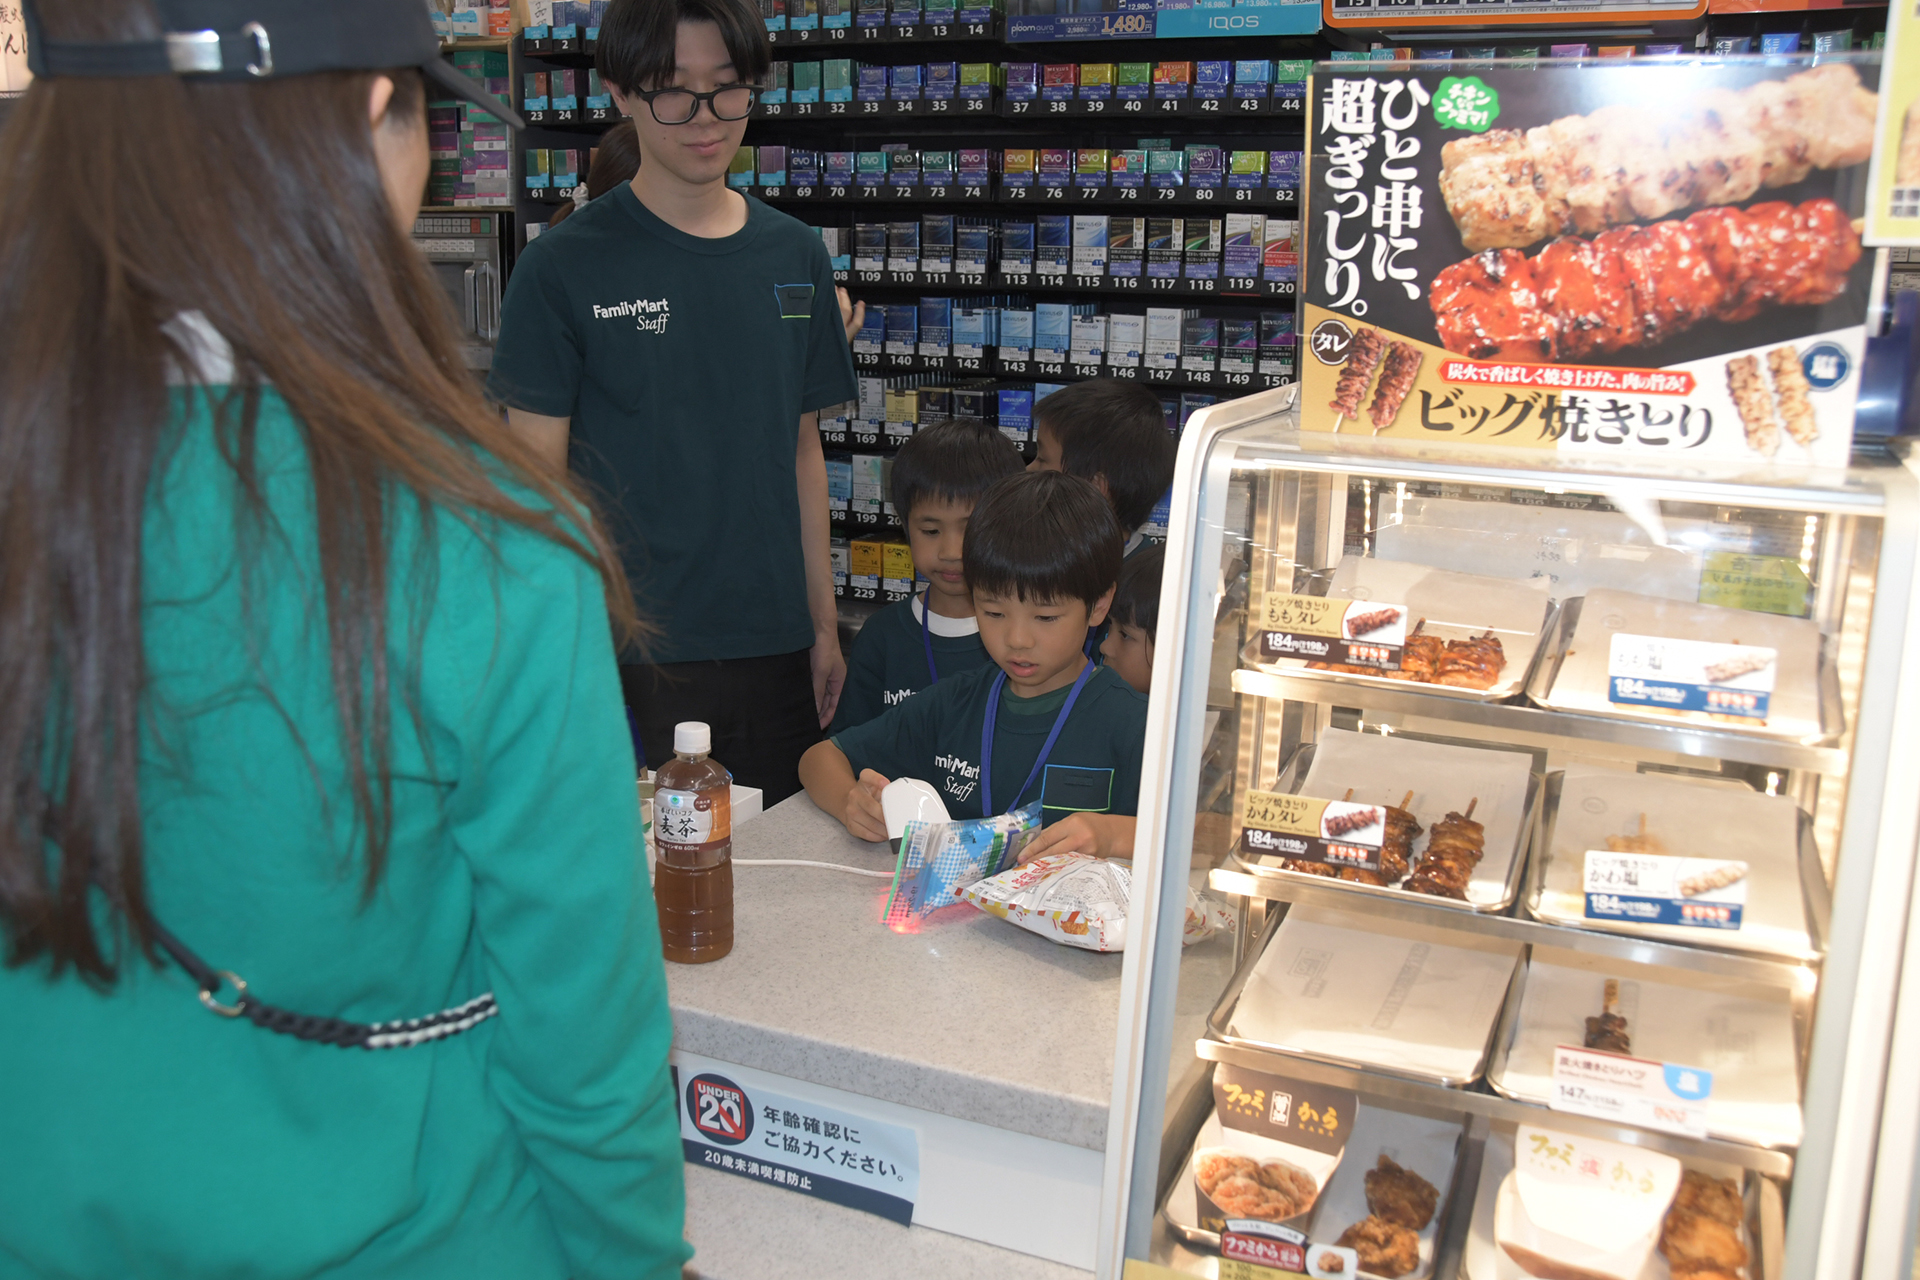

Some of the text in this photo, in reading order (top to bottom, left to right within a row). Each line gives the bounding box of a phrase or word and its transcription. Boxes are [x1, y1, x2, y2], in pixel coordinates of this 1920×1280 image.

[1209, 15, 1260, 30] IQOS
[865, 29, 876, 38] 11
[899, 27, 912, 37] 12
[933, 26, 947, 35] 13
[969, 25, 983, 34] 14
[1011, 20, 1036, 38] ploom
[770, 33, 776, 41] 8
[801, 31, 808, 40] 9
[831, 29, 844, 39] 10
[535, 40, 539, 48] 1
[562, 40, 568, 49] 2
[1448, 83, 1491, 106] チキン
[799, 104, 811, 113] 31
[831, 103, 845, 113] 32
[864, 103, 878, 112] 33
[898, 102, 912, 111] 34
[933, 101, 947, 110] 35
[968, 100, 983, 110] 36
[1014, 103, 1028, 112] 37
[1051, 102, 1066, 111] 38
[1088, 102, 1103, 111] 39
[1125, 101, 1141, 111] 40
[1162, 101, 1177, 110] 41
[1202, 100, 1218, 110] 42
[1241, 100, 1258, 110] 43
[1282, 100, 1300, 109] 44
[594, 110, 605, 118] 25
[767, 105, 780, 114] 30
[531, 112, 543, 120] 23
[559, 111, 571, 119] 24
[792, 157, 810, 165] evo
[829, 156, 847, 165] evo
[861, 156, 879, 165] evo
[894, 154, 913, 163] evo
[925, 155, 944, 164] evo
[961, 154, 980, 163] evo
[1006, 154, 1026, 163] evo
[1043, 154, 1063, 162] evo
[1080, 153, 1100, 162] evo
[532, 189, 543, 197] 61
[559, 189, 572, 197] 62
[766, 187, 779, 196] 68
[797, 187, 811, 196] 69
[831, 187, 845, 196] 70
[864, 188, 876, 196] 71
[897, 187, 911, 196] 72
[931, 187, 945, 196] 73
[965, 187, 980, 196] 74
[1010, 188, 1025, 198] 75
[1047, 188, 1062, 198] 76
[1083, 189, 1098, 198] 77
[1121, 189, 1136, 198] 78
[1371, 77, 1431, 301] ひと串に、
[1159, 189, 1175, 199] 79
[1196, 190, 1213, 199] 80
[1236, 190, 1251, 200] 81
[1276, 190, 1293, 200] 82
[1321, 77, 1377, 317] 超ぎっしり。
[834, 271, 848, 280] 08
[860, 272, 881, 281] 109
[892, 273, 913, 282] 110
[926, 274, 946, 283] 111
[960, 275, 981, 284] 112
[1006, 275, 1027, 284] 113
[1041, 276, 1063, 285] 114
[1077, 277, 1099, 286] 115
[1114, 278, 1137, 288] 116
[1152, 279, 1175, 289] 117
[1190, 280, 1213, 290] 118
[1229, 279, 1254, 288] 119
[1269, 283, 1294, 293] 120
[593, 298, 669, 319] FamilyMart
[637, 313, 670, 334] Staff
[1315, 333, 1343, 354] タレ
[858, 355, 878, 364] 139
[891, 356, 911, 365] 140
[924, 357, 943, 367] 141
[958, 359, 979, 368] 142
[1004, 362, 1025, 372] 143
[1039, 364, 1061, 374] 144
[1075, 366, 1097, 375] 145
[1112, 368, 1135, 378] 146
[1149, 370, 1172, 380] 147
[1187, 372, 1210, 382] 148
[1225, 374, 1249, 384] 149
[1264, 376, 1290, 386] 150
[1418, 387, 1713, 449] ビッグ焼きとり
[825, 432, 845, 442] 168
[856, 434, 876, 443] 169
[832, 511, 845, 520] 98
[857, 514, 877, 523] 199
[855, 589, 875, 598] 229
[1269, 597, 1330, 612] ビッグ焼きとり
[944, 776, 977, 802] Staff
[1249, 795, 1308, 811] ビッグ焼きとり
[1246, 806, 1304, 824] かわタレ
[660, 814, 698, 838] 麦茶
[697, 1083, 740, 1102] UNDER
[1222, 1083, 1266, 1112] ファミ
[699, 1094, 742, 1134] 20
[1297, 1101, 1338, 1130] から
[763, 1105, 862, 1144] 年齢確認に
[1227, 1104, 1334, 1138] FAMI KARA
[1529, 1133, 1575, 1166] ファミ
[764, 1130, 904, 1182] ご協力ください。
[705, 1151, 812, 1191] 20歳未満喫煙防止
